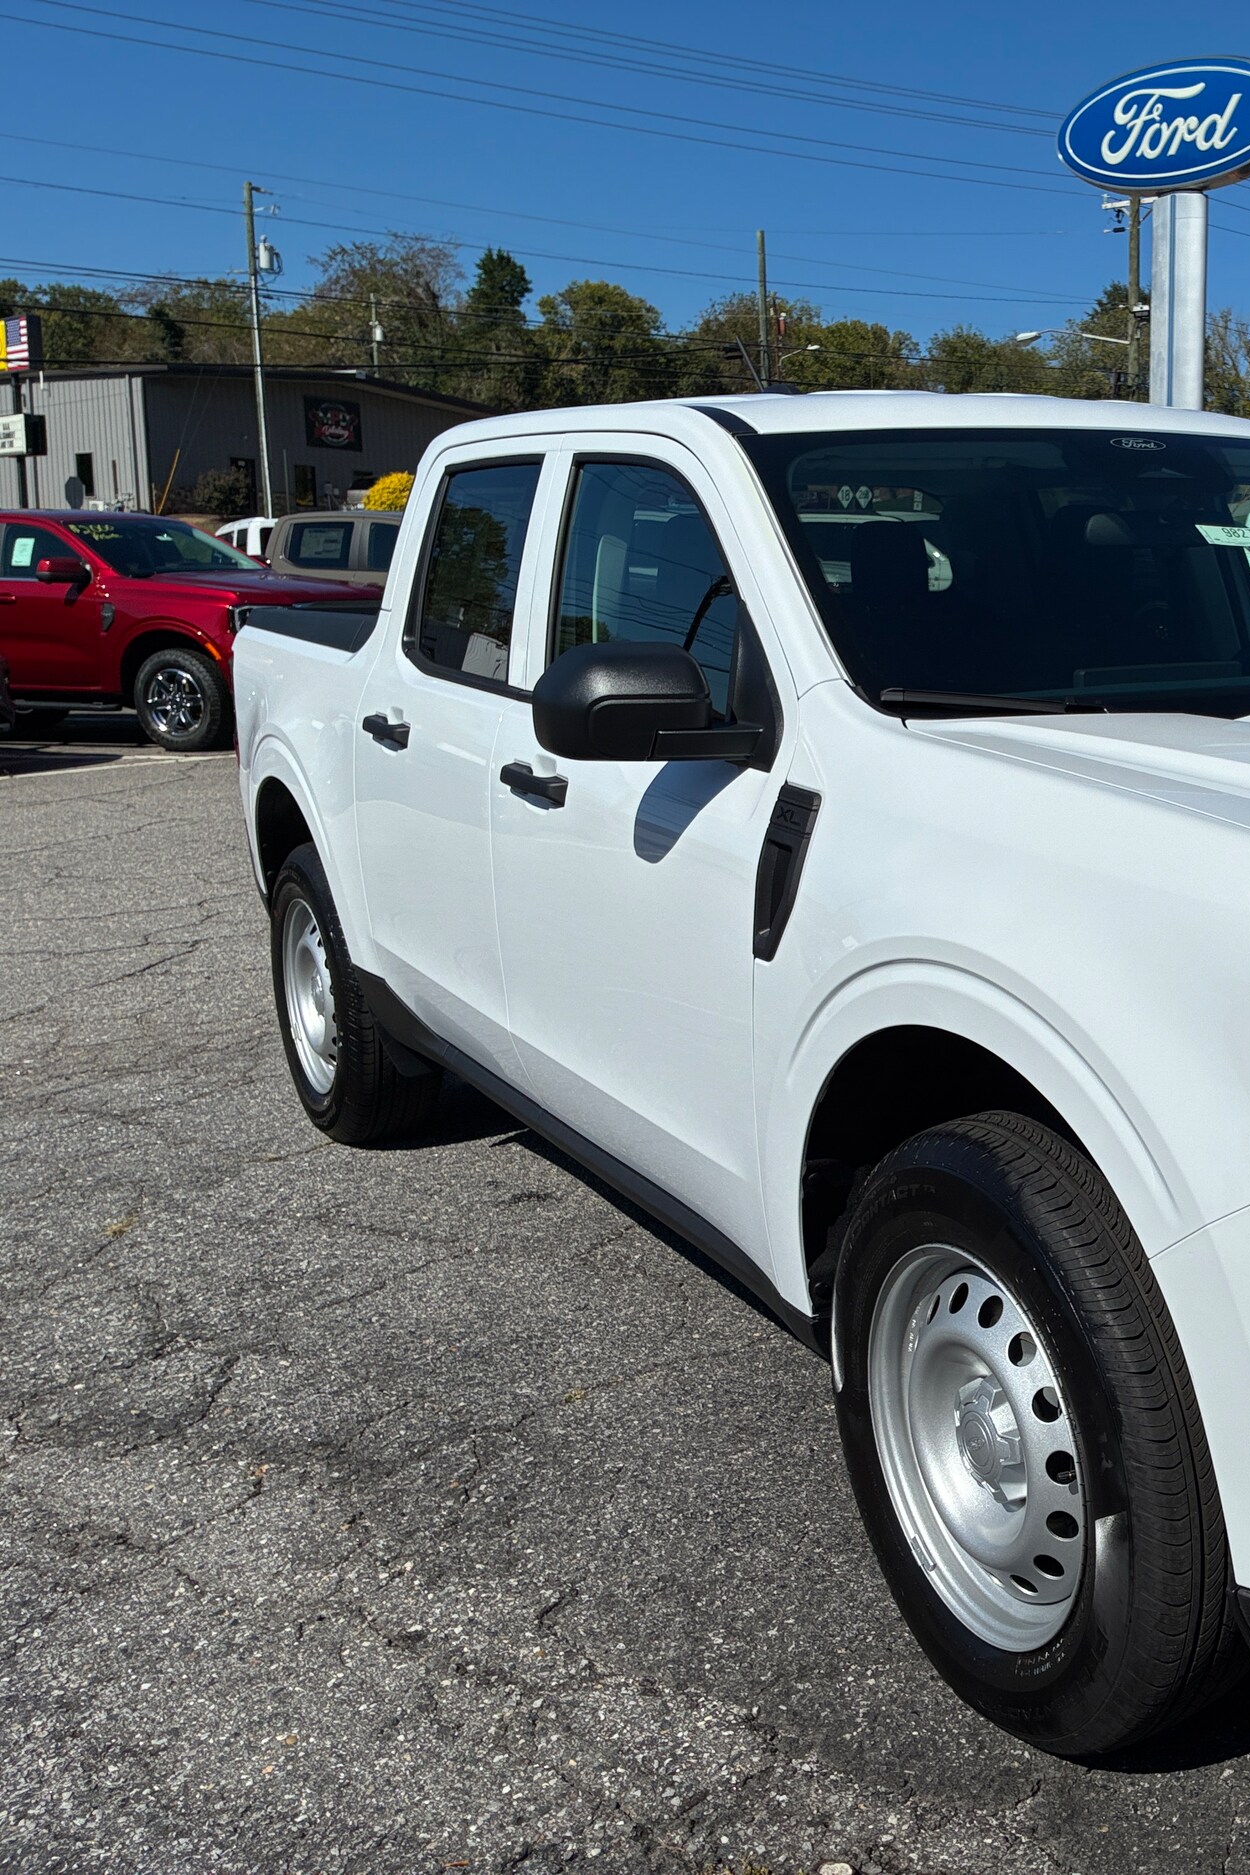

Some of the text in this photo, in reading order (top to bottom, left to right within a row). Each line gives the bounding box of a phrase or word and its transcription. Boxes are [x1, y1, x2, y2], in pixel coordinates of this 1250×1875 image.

[1100, 82, 1242, 165] Ford
[1122, 440, 1157, 448] Ford
[776, 806, 800, 825] XL
